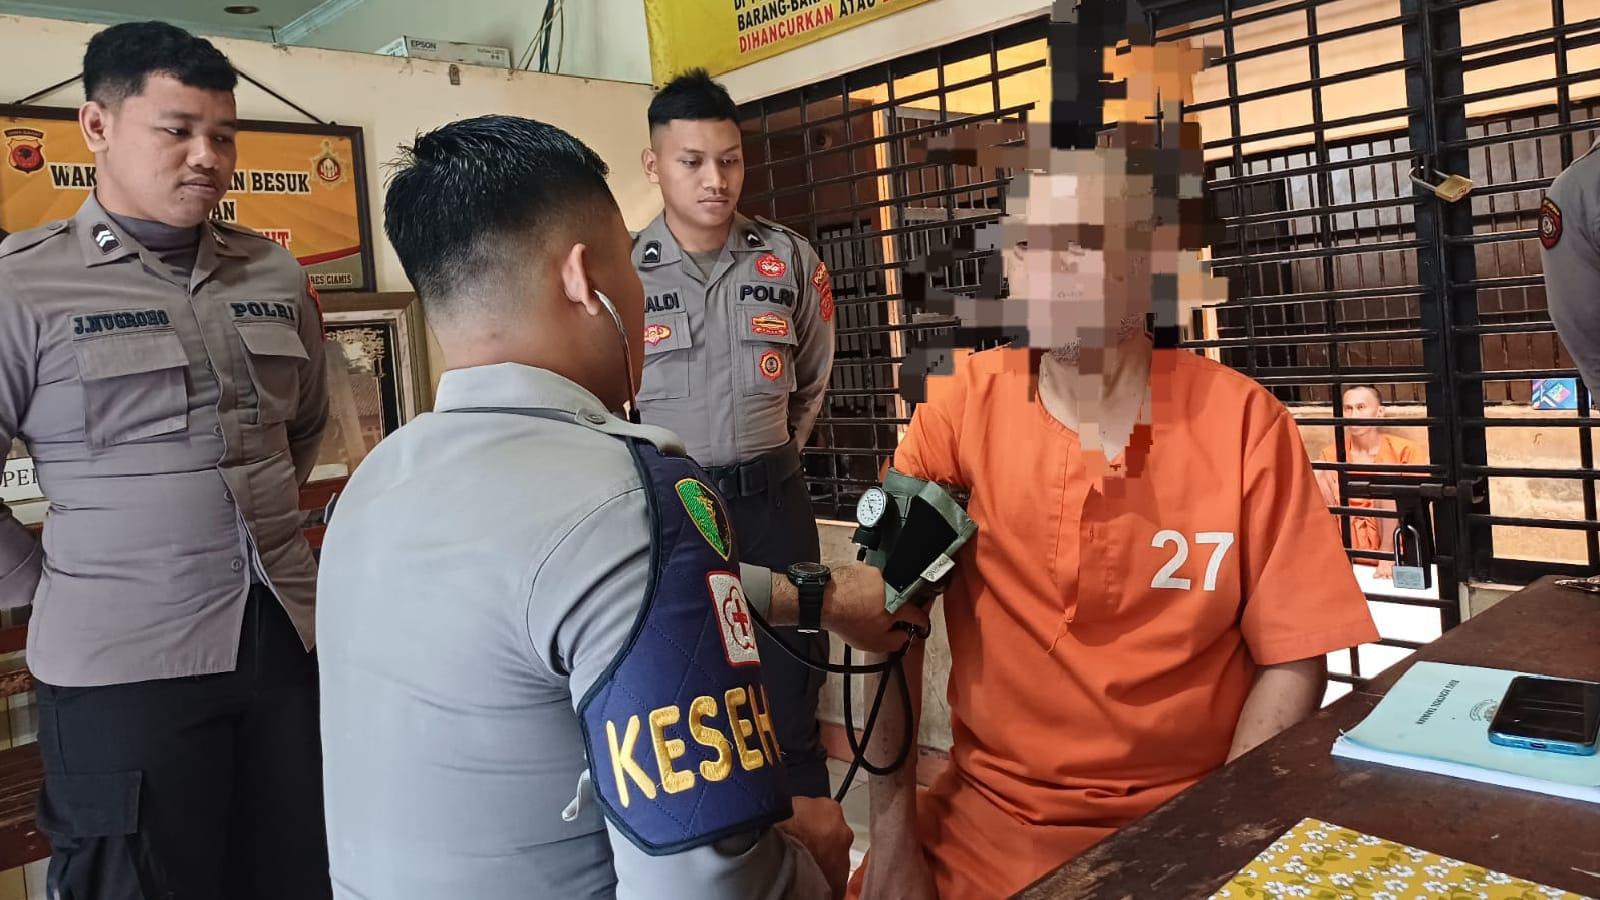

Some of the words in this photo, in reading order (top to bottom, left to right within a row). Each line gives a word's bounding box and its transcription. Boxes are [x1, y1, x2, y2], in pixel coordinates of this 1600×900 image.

[738, 0, 820, 31] BARANG-BA
[740, 4, 833, 53] DIHANCURKAN
[411, 40, 436, 49] EPSON
[251, 172, 310, 192] BESUK
[326, 274, 352, 285] CIAMIS
[230, 302, 295, 321] POLRI
[1150, 529, 1235, 592] 27
[606, 684, 783, 809] KESEH
